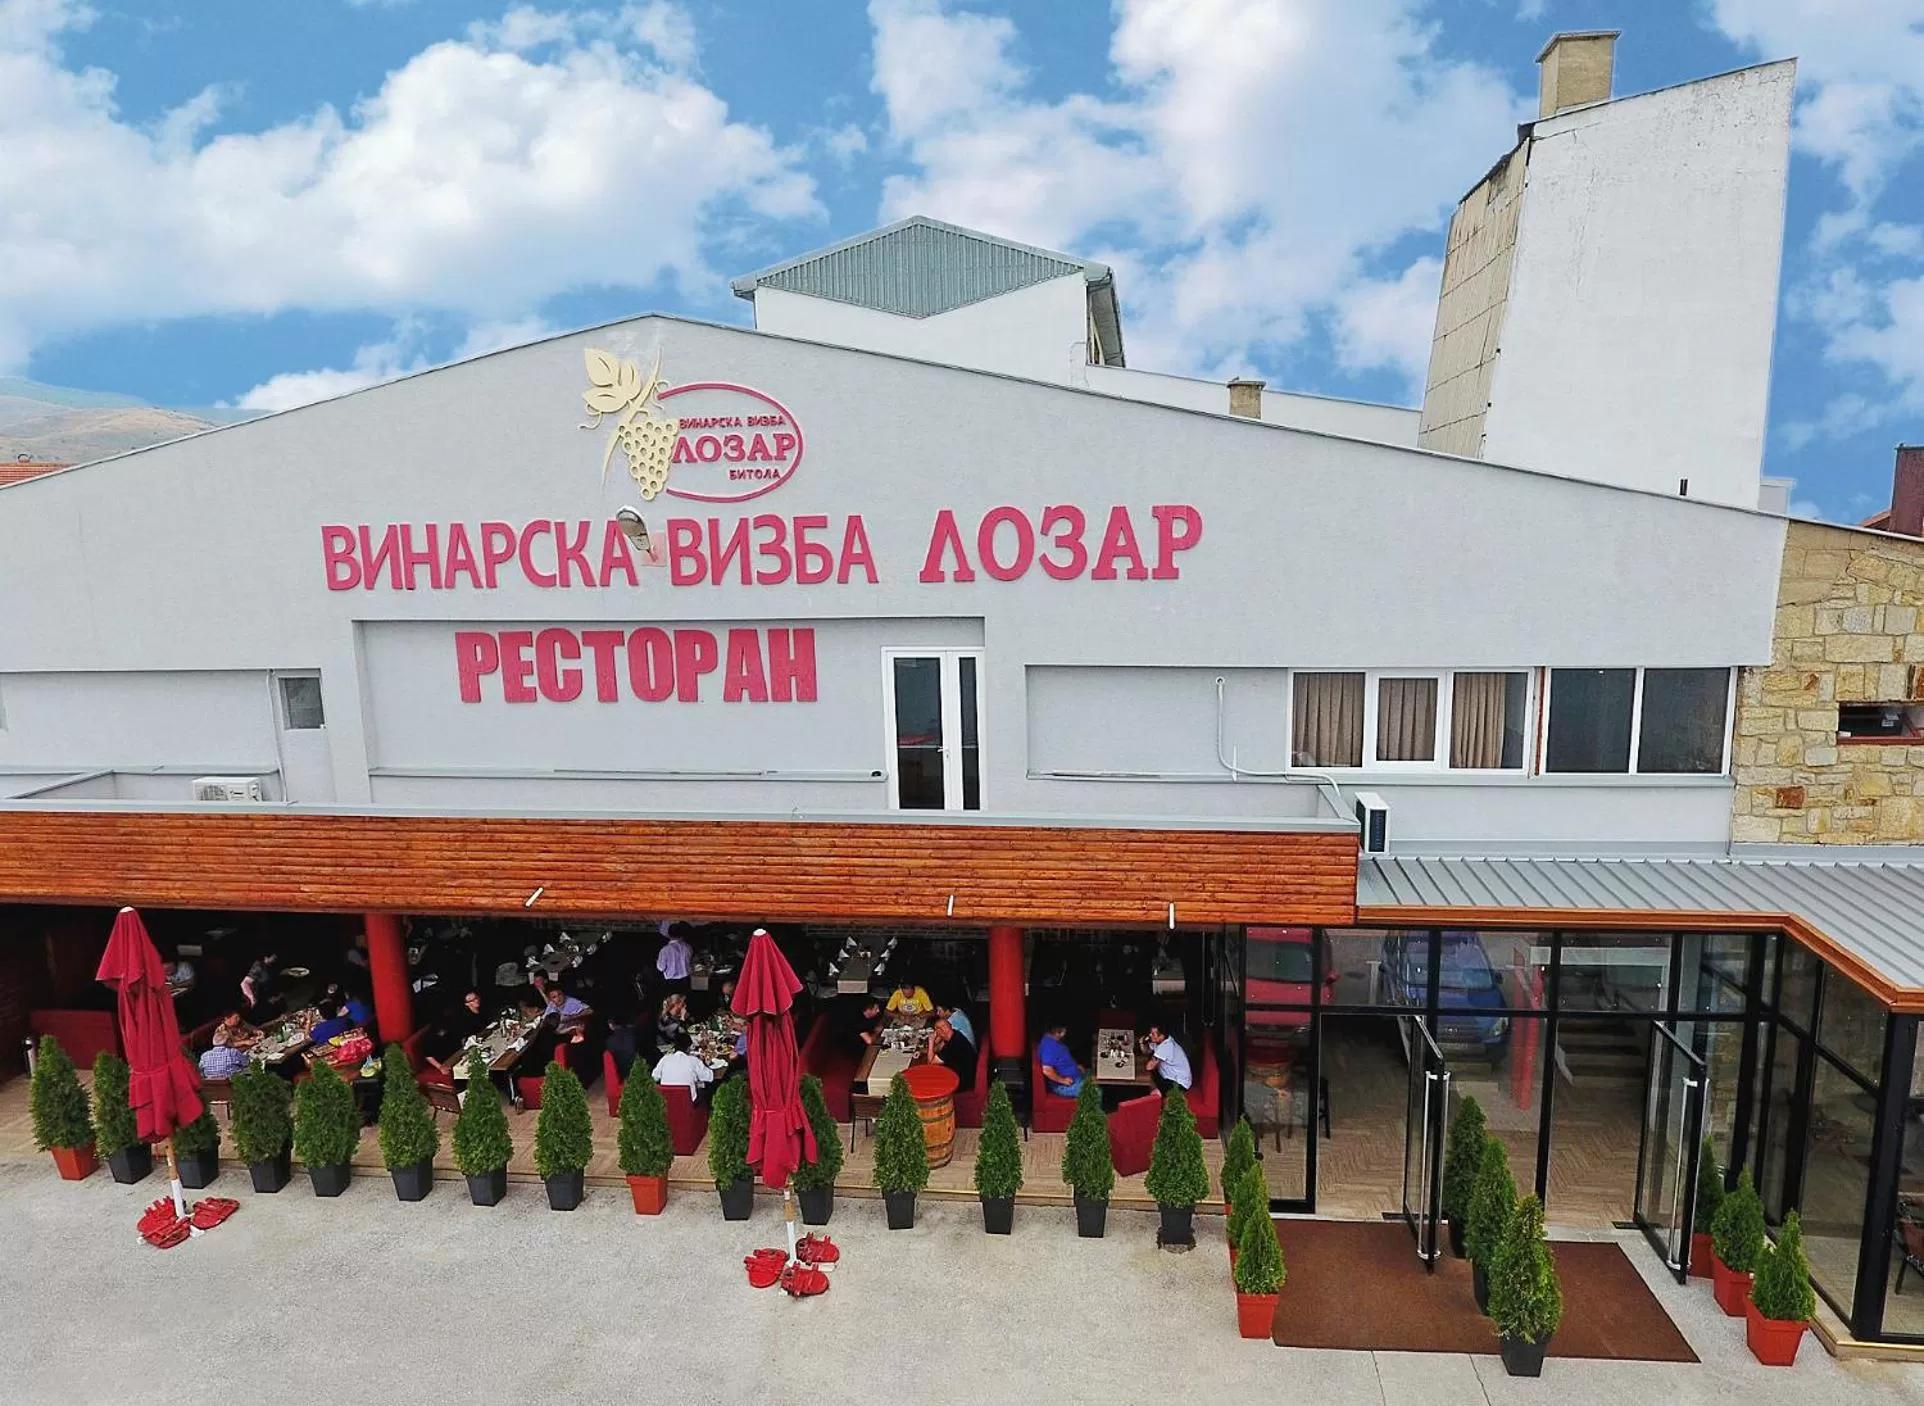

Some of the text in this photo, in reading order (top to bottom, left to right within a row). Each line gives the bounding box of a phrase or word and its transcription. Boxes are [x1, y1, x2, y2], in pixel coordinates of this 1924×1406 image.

[679, 415, 786, 429] ВИНАРСКА ВИЗБА
[672, 433, 796, 463] ЛОЗАР
[729, 469, 781, 480] БИТОЛА
[321, 504, 1203, 590] ВИНАРСКА ВИЗБА ЛОЗАР
[455, 627, 818, 703] РЕСТОРАН
